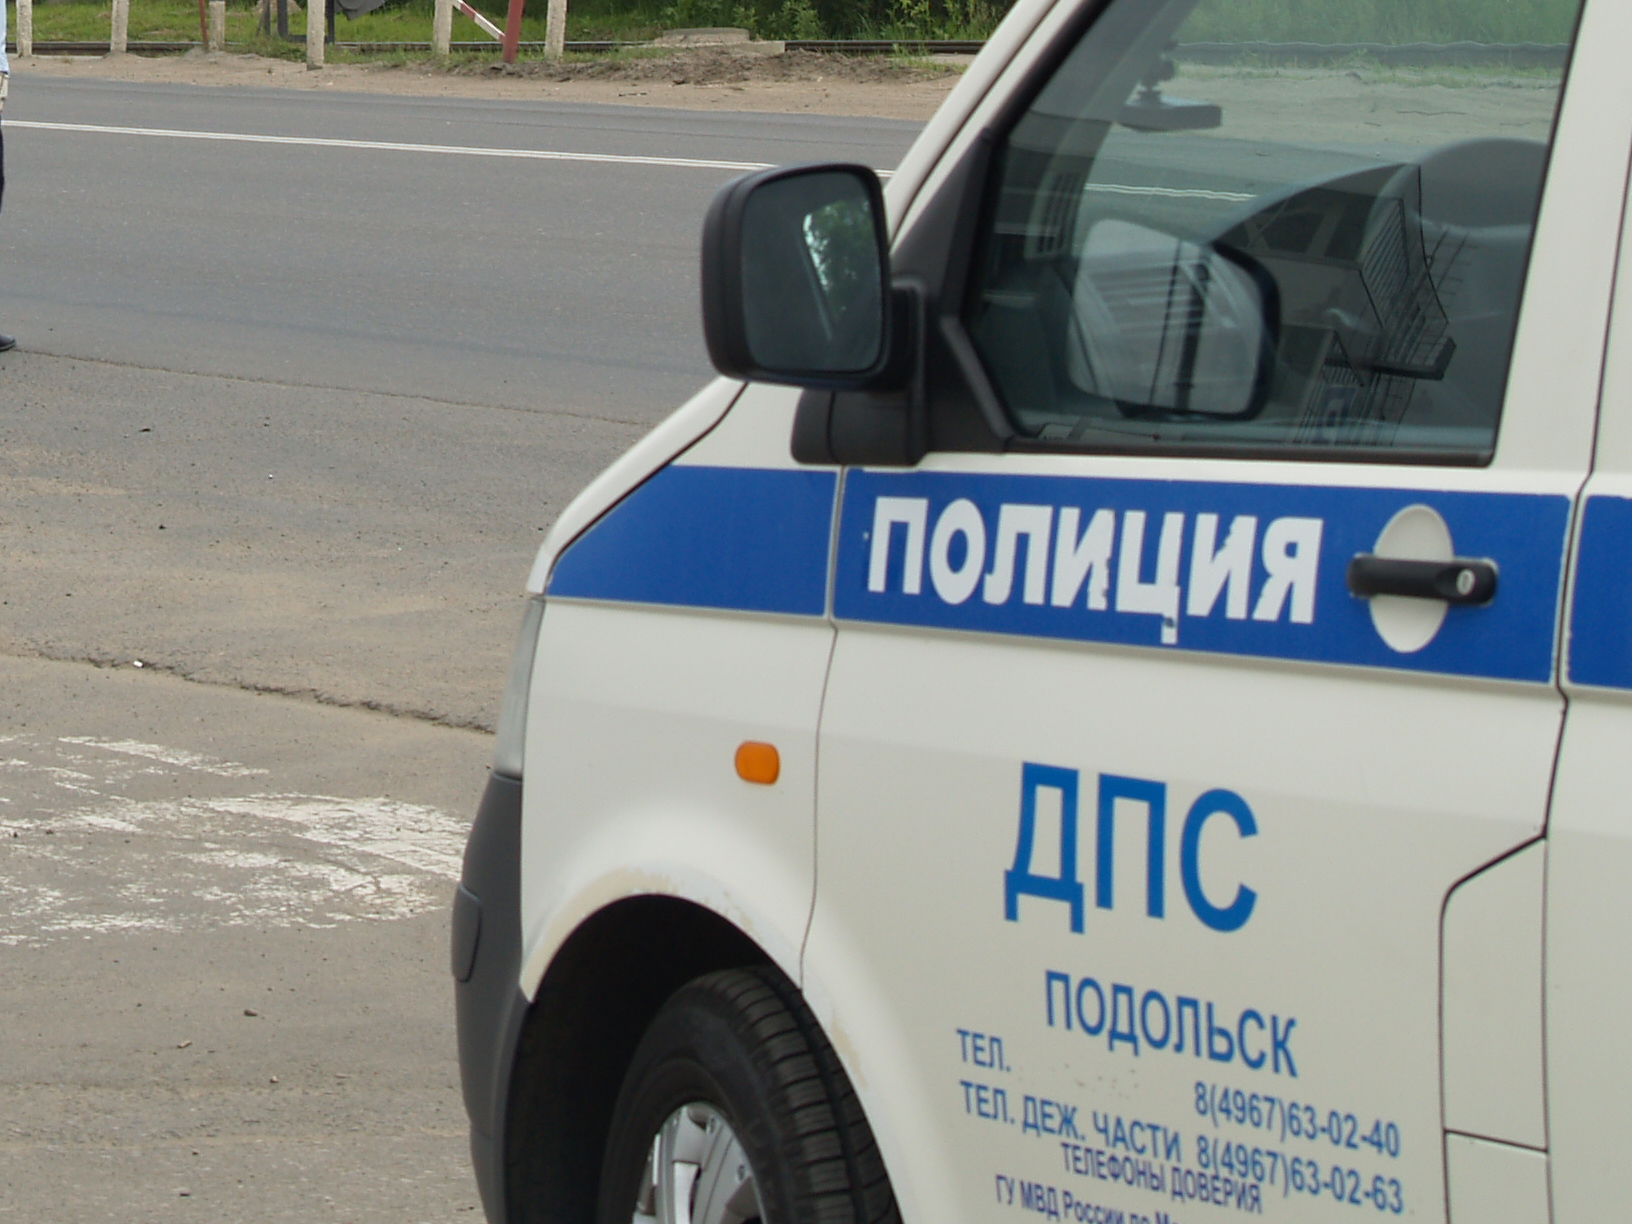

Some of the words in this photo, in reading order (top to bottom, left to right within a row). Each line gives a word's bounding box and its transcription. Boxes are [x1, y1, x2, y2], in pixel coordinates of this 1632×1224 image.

[867, 495, 1324, 644] ПОЛИЦИЯ
[1003, 761, 1258, 934] ДПС
[1045, 969, 1298, 1078] ПОДОЛЬСК
[956, 1028, 1011, 1073] ТЕЛ.
[1194, 1081, 1401, 1158] 8(4967)63-02-40
[959, 1079, 1015, 1125] ТЕЛ.
[1022, 1094, 1086, 1142] ДЕЖ.
[1092, 1110, 1182, 1163] ЧАСТИ
[1197, 1135, 1404, 1215] 8(4967)63-02-63
[995, 1174, 1016, 1206] ГУ
[1020, 1180, 1061, 1222] МВД
[1061, 1141, 1166, 1194] ТЕЛЕФОНЫ
[1170, 1167, 1264, 1215] ДОВЕРИЯ
